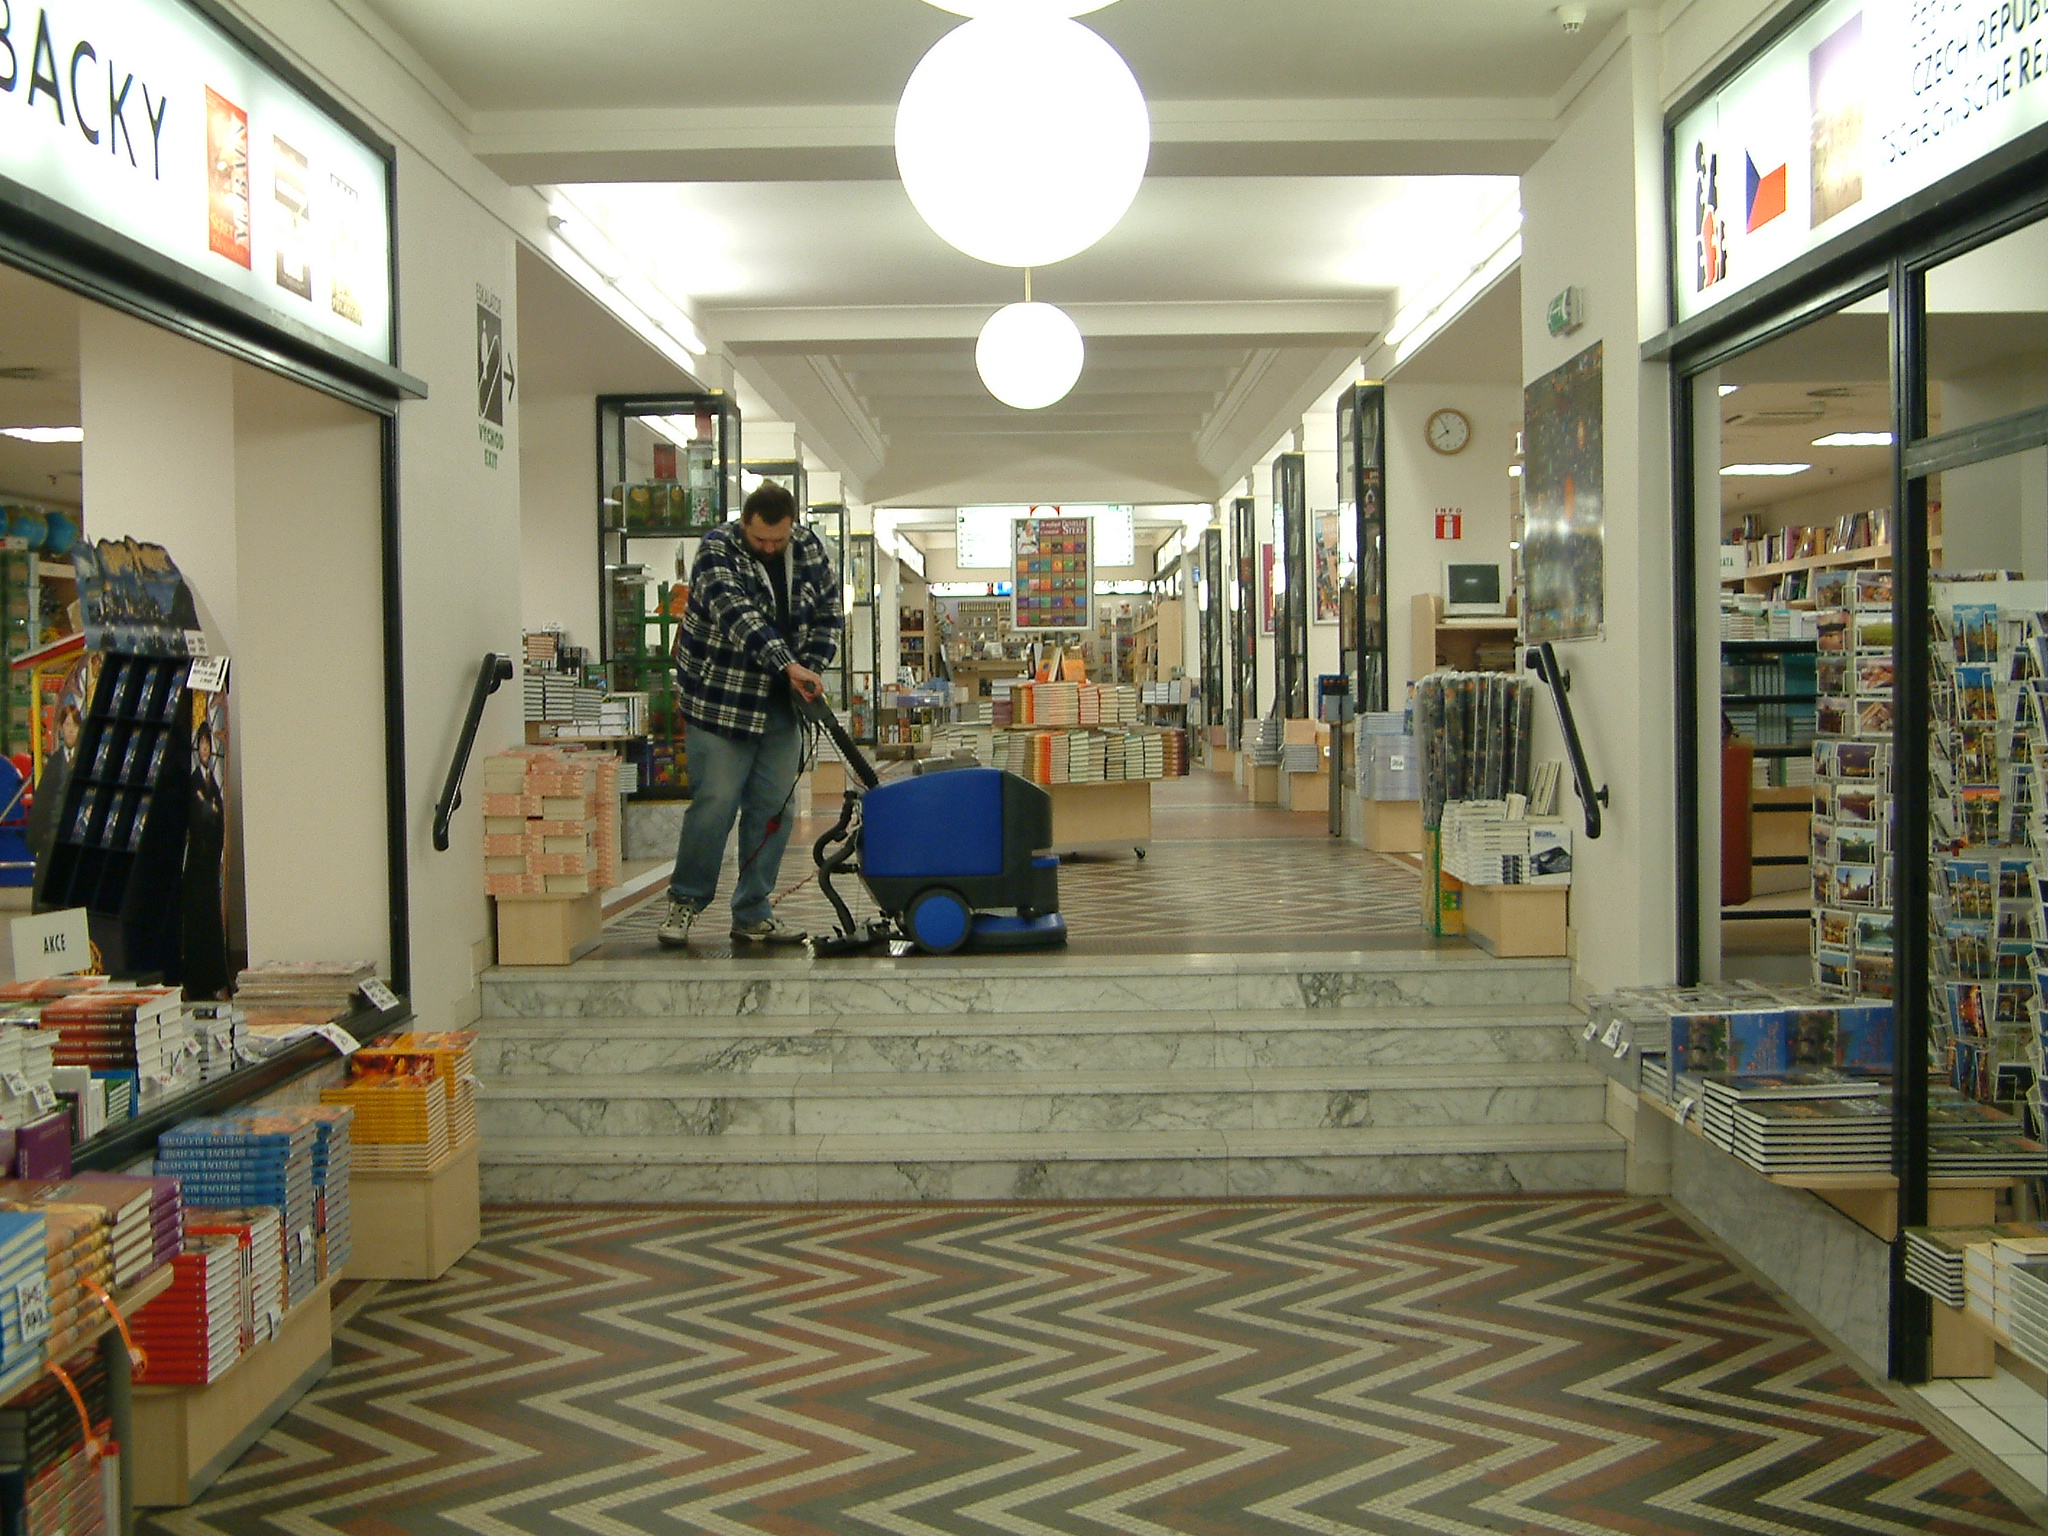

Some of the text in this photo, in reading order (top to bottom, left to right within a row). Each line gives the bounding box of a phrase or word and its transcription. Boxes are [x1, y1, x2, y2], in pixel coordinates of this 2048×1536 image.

[1913, 33, 1968, 96] CZECH
[2018, 37, 2048, 89] RE
[484, 448, 498, 470] EXIT
[44, 933, 66, 955] AKCE
